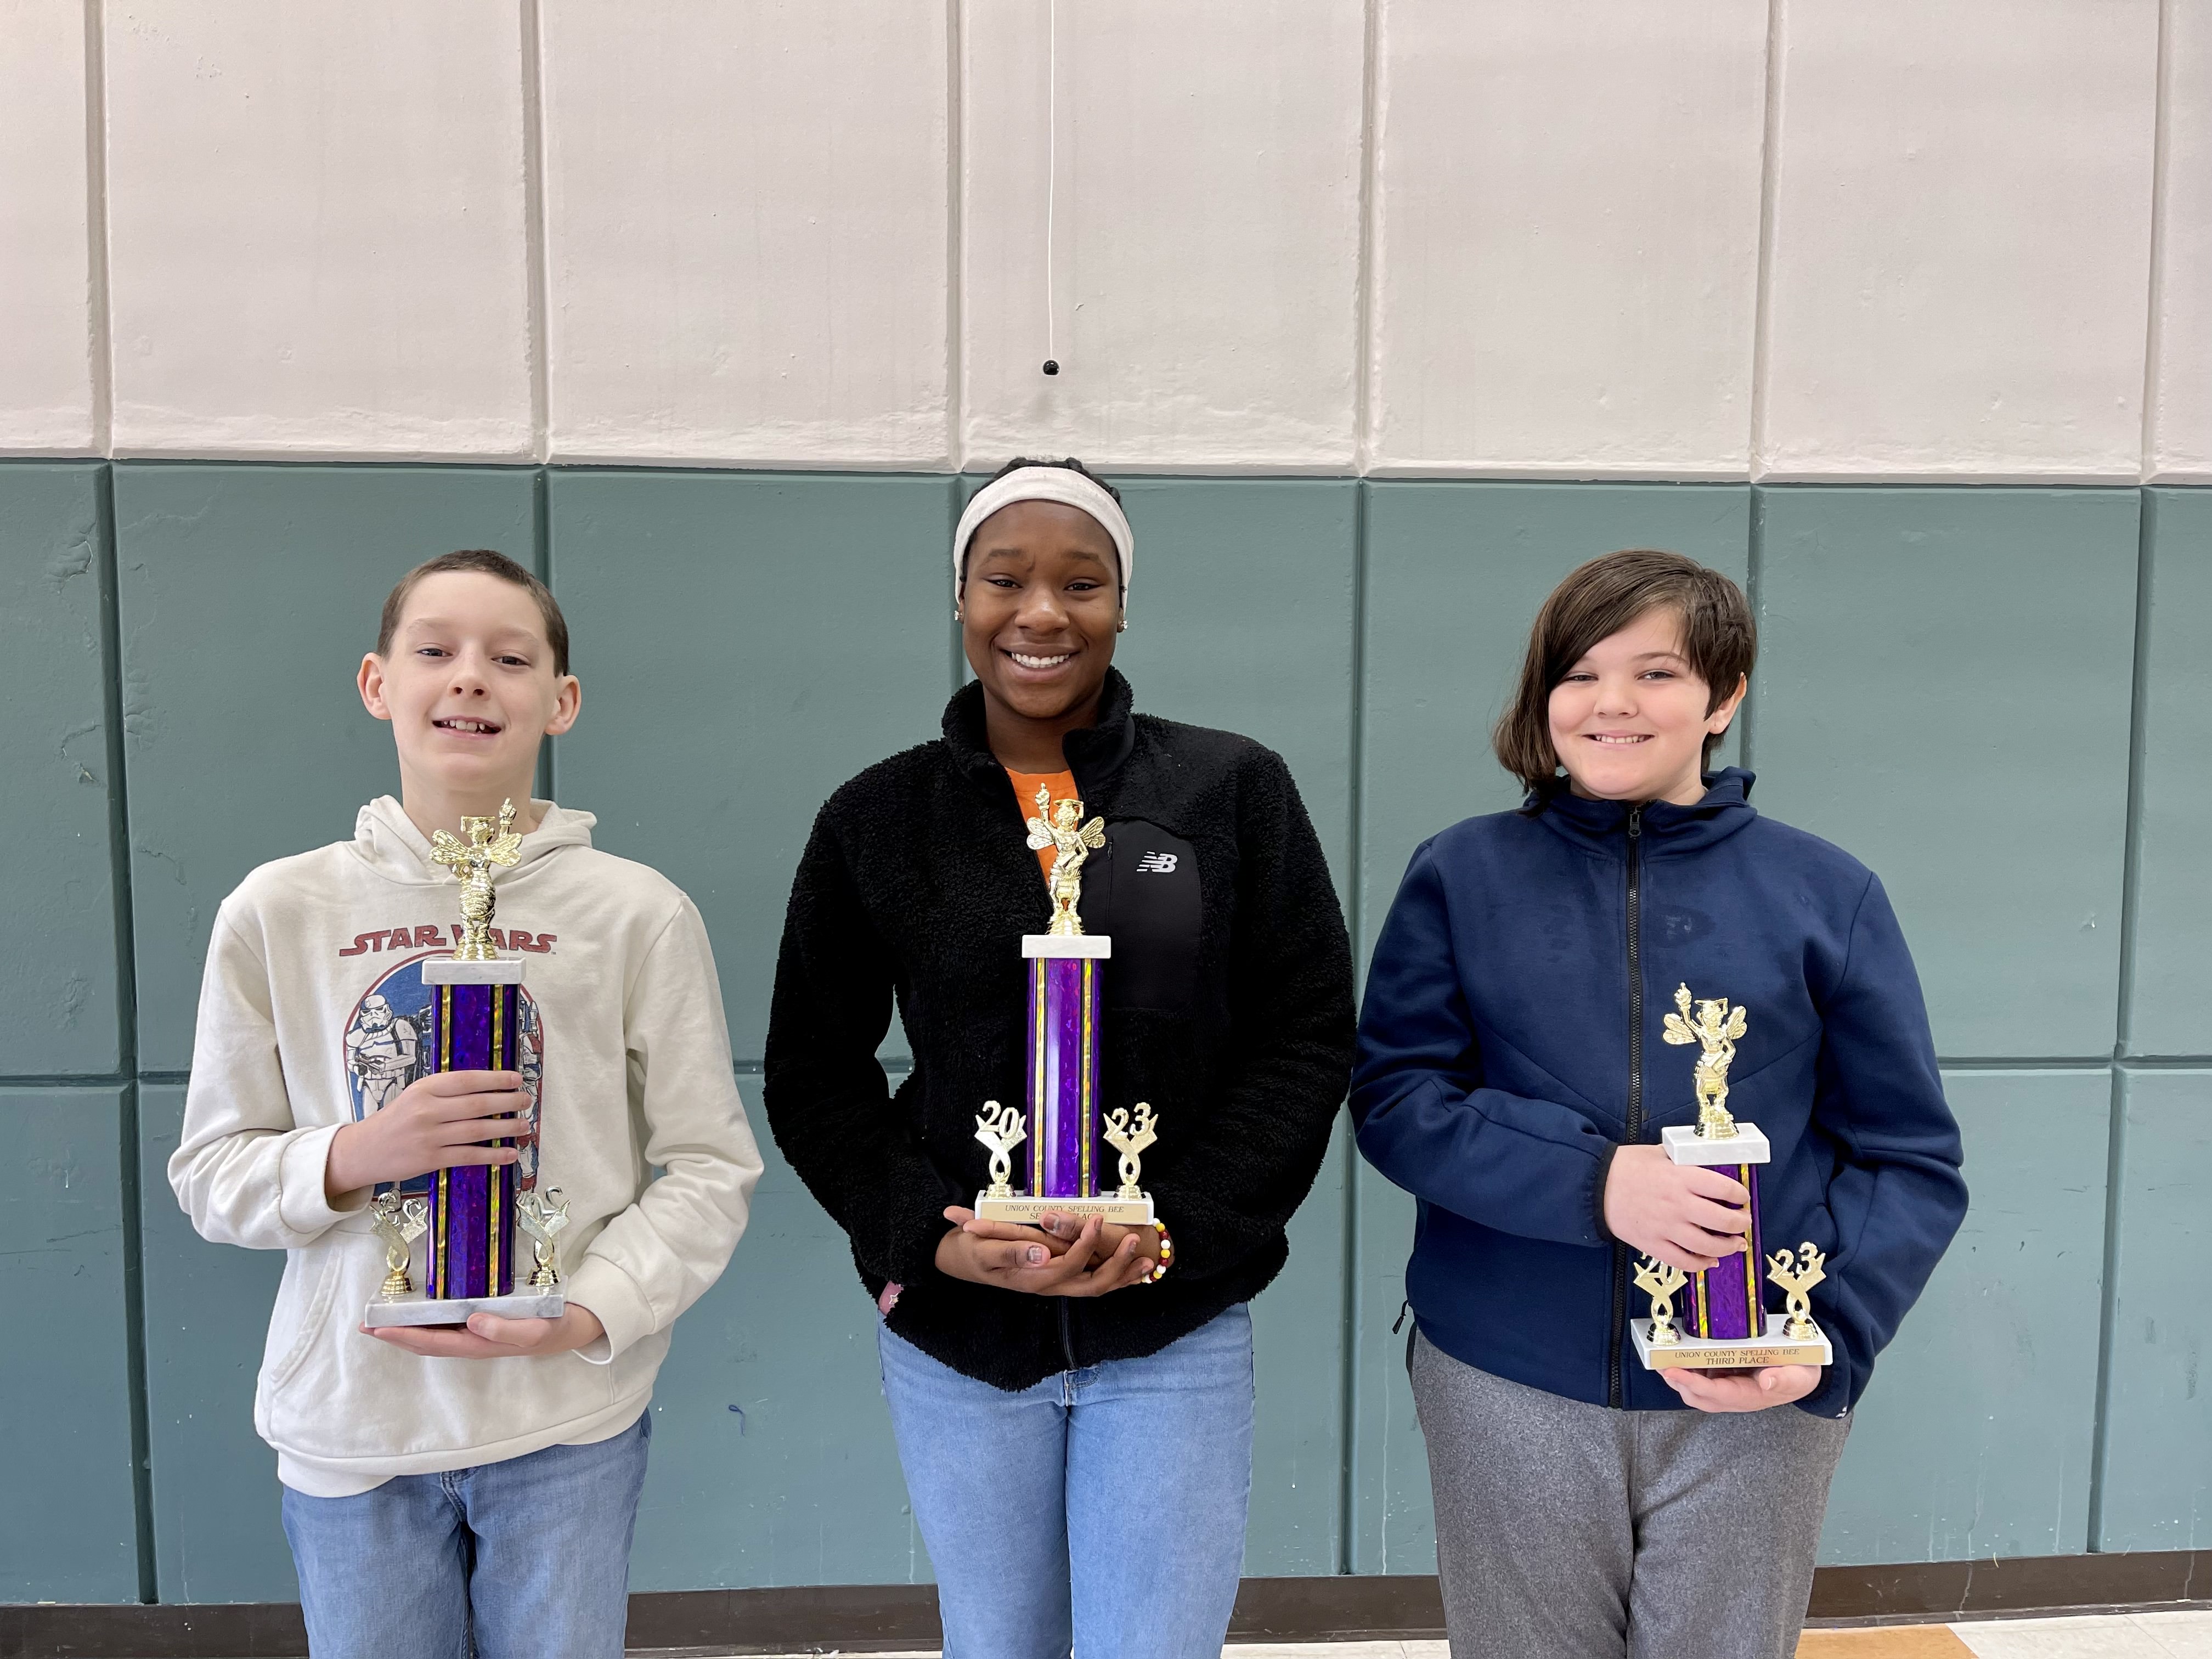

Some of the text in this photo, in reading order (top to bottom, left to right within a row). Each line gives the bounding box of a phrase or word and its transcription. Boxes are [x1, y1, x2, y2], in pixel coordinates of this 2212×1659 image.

[339, 924, 447, 957] STAR
[981, 1100, 1020, 1139] 20
[1109, 1102, 1152, 1141] 23
[1768, 1241, 1818, 1280] 23
